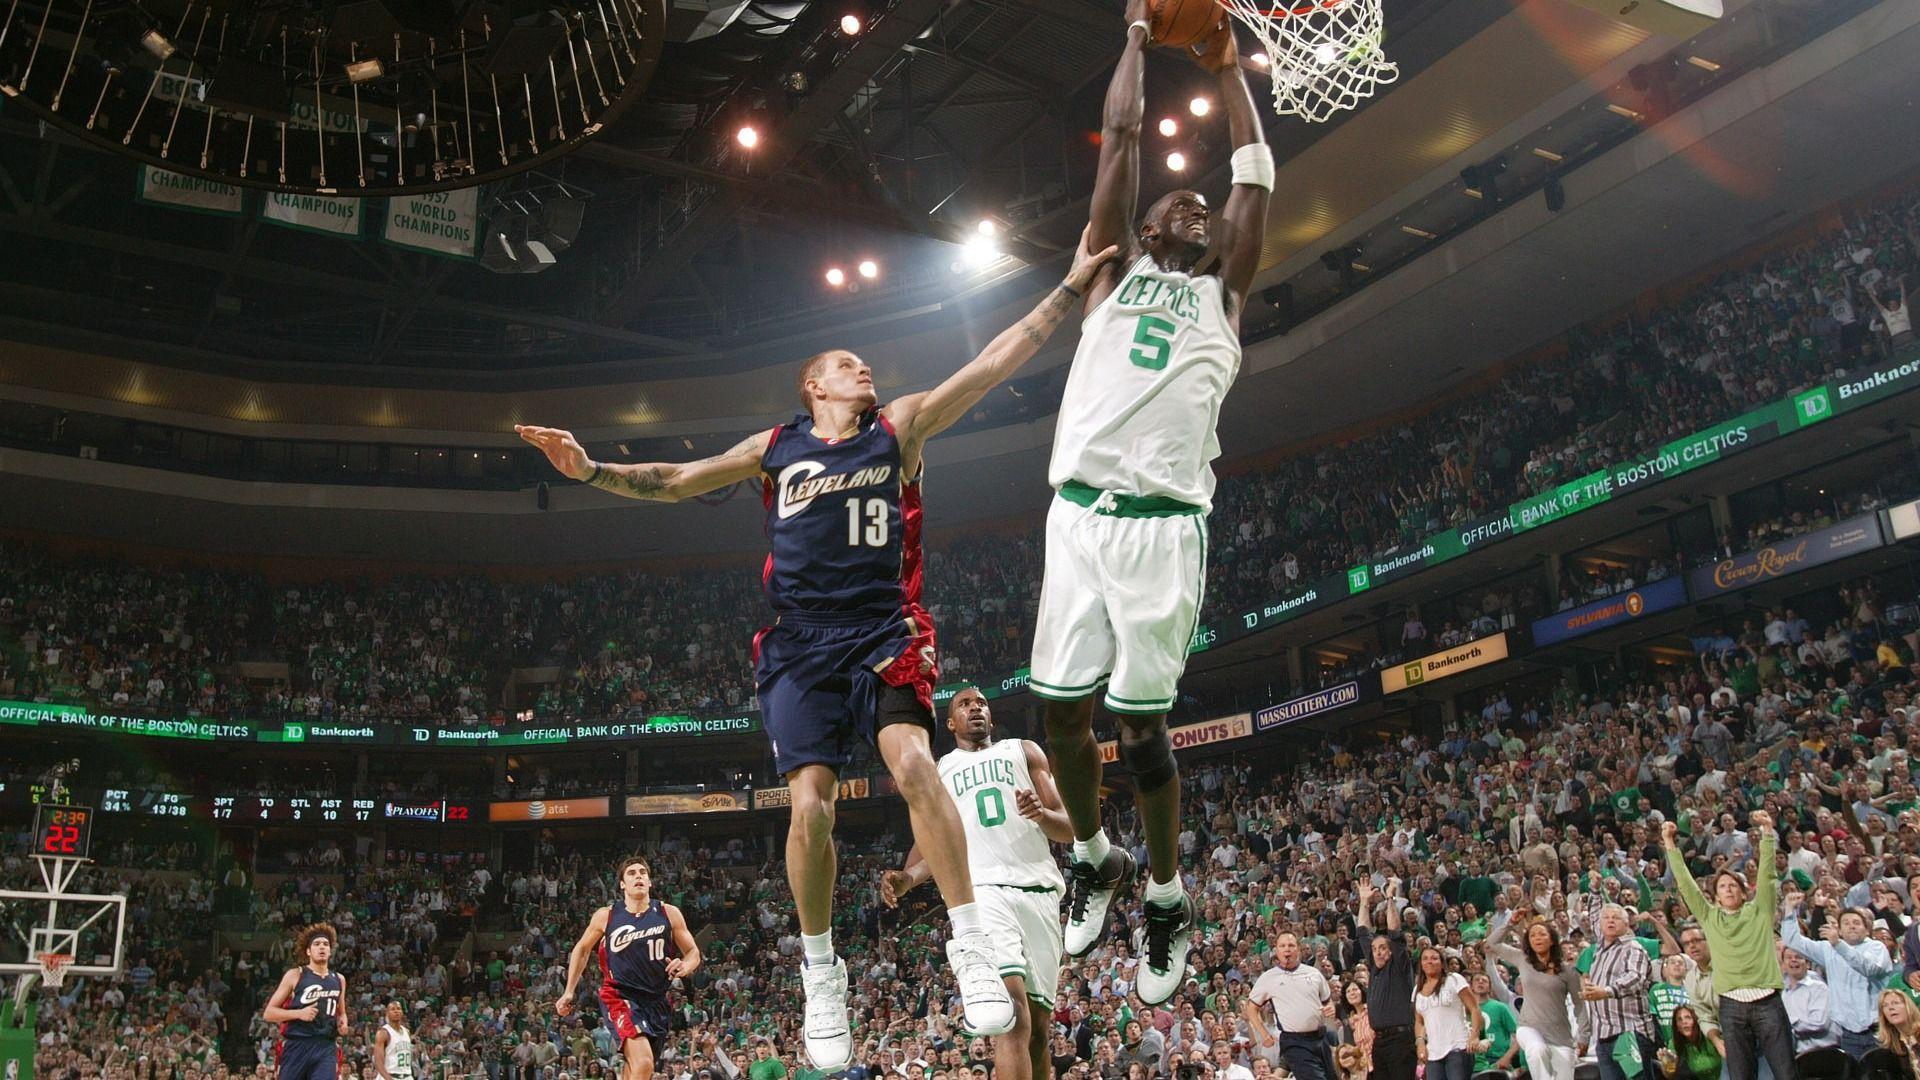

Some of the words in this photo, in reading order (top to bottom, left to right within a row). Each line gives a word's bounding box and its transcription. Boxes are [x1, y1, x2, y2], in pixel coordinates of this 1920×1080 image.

[291, 101, 361, 131] OSTON
[151, 170, 236, 197] CHAMPIONS
[273, 192, 354, 219] CHAMPIONS
[410, 201, 457, 222] WORLD
[393, 214, 470, 241] CHAMPIONS
[1128, 315, 1177, 371] 5
[778, 460, 891, 520] CLEVELAND
[1461, 514, 1519, 546] OFFICIAL
[1521, 498, 1560, 524] BANK
[1562, 489, 1581, 508] OF
[1583, 476, 1614, 500] THE
[1616, 451, 1680, 487] BOSTON
[1683, 426, 1748, 462] CELTICS
[845, 497, 889, 548] 13
[1374, 544, 1435, 577] Banknorth
[1713, 559, 1758, 589] Crown
[1749, 540, 1808, 582] Royal
[1243, 612, 1258, 629] TD
[1264, 589, 1317, 618] Banknorth
[1567, 602, 1626, 630] SYLVANIA
[1191, 629, 1217, 647] TICS
[1427, 647, 1482, 672] Banknorth
[1001, 675, 1031, 691] OFFIC
[1259, 685, 1356, 727] MASSLOTTERY.COM
[0, 706, 57, 722] OFFICIAL
[61, 711, 97, 726] BANK
[99, 715, 117, 727] OF
[120, 717, 145, 730] THE
[148, 719, 198, 734] BOSTON
[200, 724, 249, 737] CELTICS
[311, 726, 374, 737] Banknorth
[412, 728, 430, 742] TD
[438, 729, 499, 739] Banknorth
[523, 727, 574, 740] OFFICIAL
[577, 725, 608, 738] BANK
[611, 724, 627, 736] OF
[630, 723, 652, 735] THE
[655, 720, 702, 734] BOSTON
[704, 717, 750, 732] CELTICS
[1171, 723, 1229, 748] ONUTS
[952, 758, 1015, 797] CELTICS
[106, 789, 129, 800] PCT
[163, 793, 179, 803] FG
[214, 797, 235, 807] 3PT
[259, 798, 274, 807] TO
[290, 798, 310, 808] STL
[320, 799, 342, 809] AST
[353, 800, 375, 809] REB
[392, 805, 439, 817] PLAYOFFS
[447, 806, 469, 819] 22
[975, 786, 1006, 828] 0
[53, 811, 86, 825] 2:39
[259, 809, 268, 819] 4
[293, 809, 301, 820] 3
[323, 810, 337, 820] 10
[355, 810, 370, 821] 17
[45, 825, 79, 852] 22
[610, 924, 665, 953] CLEVELAND
[646, 938, 665, 961] 10
